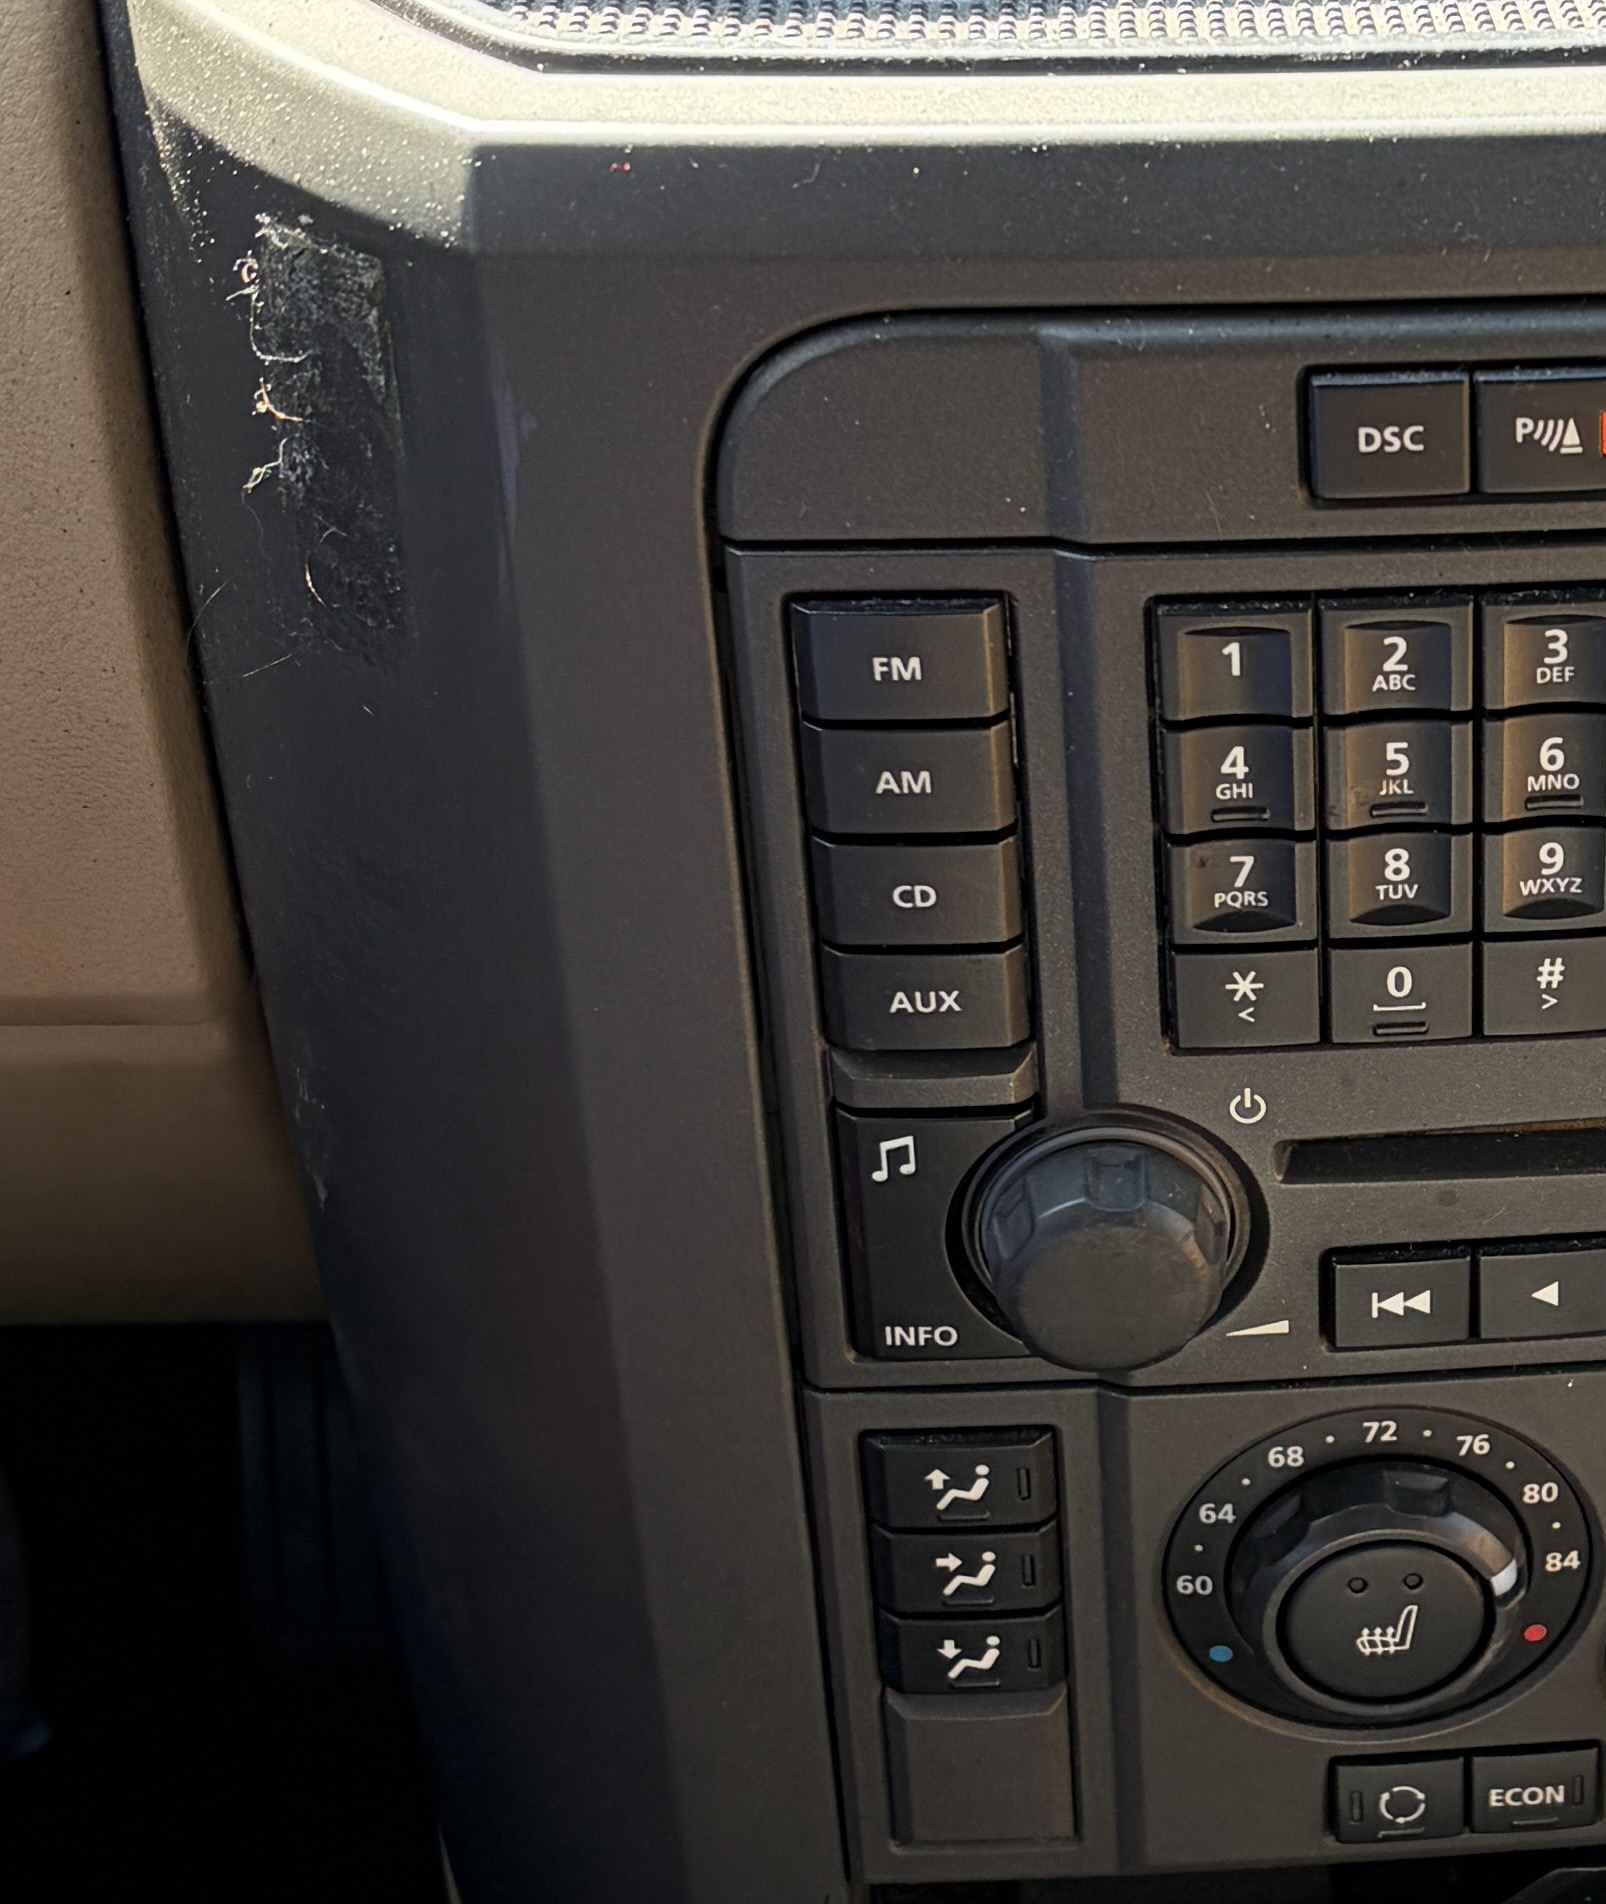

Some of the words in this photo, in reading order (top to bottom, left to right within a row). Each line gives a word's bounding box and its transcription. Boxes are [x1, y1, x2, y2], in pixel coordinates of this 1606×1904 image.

[1358, 426, 1424, 453] DSC
[1382, 637, 1408, 671] 2
[1543, 629, 1568, 664] 3
[872, 657, 922, 681] FM
[1222, 642, 1242, 677] 1
[1372, 674, 1416, 691] ABC
[1536, 667, 1575, 684] DEF
[1220, 746, 1249, 780] 4
[1385, 742, 1410, 776] 5
[1539, 737, 1565, 771] 6
[876, 770, 932, 794] AM
[1215, 783, 1254, 799] GHI
[1379, 779, 1414, 795] JKL
[1527, 774, 1580, 791] MNO
[1384, 848, 1410, 881] 8
[1538, 842, 1564, 875] 9
[1230, 855, 1255, 888] 7
[892, 885, 936, 909] CD
[1376, 884, 1419, 900] TUV
[1519, 877, 1582, 896] WXYZ
[1214, 892, 1268, 909] PQRS
[1387, 966, 1412, 997] 0
[889, 991, 961, 1013] AUX
[884, 1325, 958, 1347] INFO
[1176, 1575, 1213, 1596] 60
[1199, 1503, 1236, 1524] 64
[1267, 1446, 1304, 1467] 68
[1363, 1421, 1398, 1443] 72
[1456, 1434, 1491, 1456] 76
[1523, 1482, 1558, 1504] 80
[1545, 1551, 1581, 1573] 84
[1489, 1785, 1565, 1807] ECON
